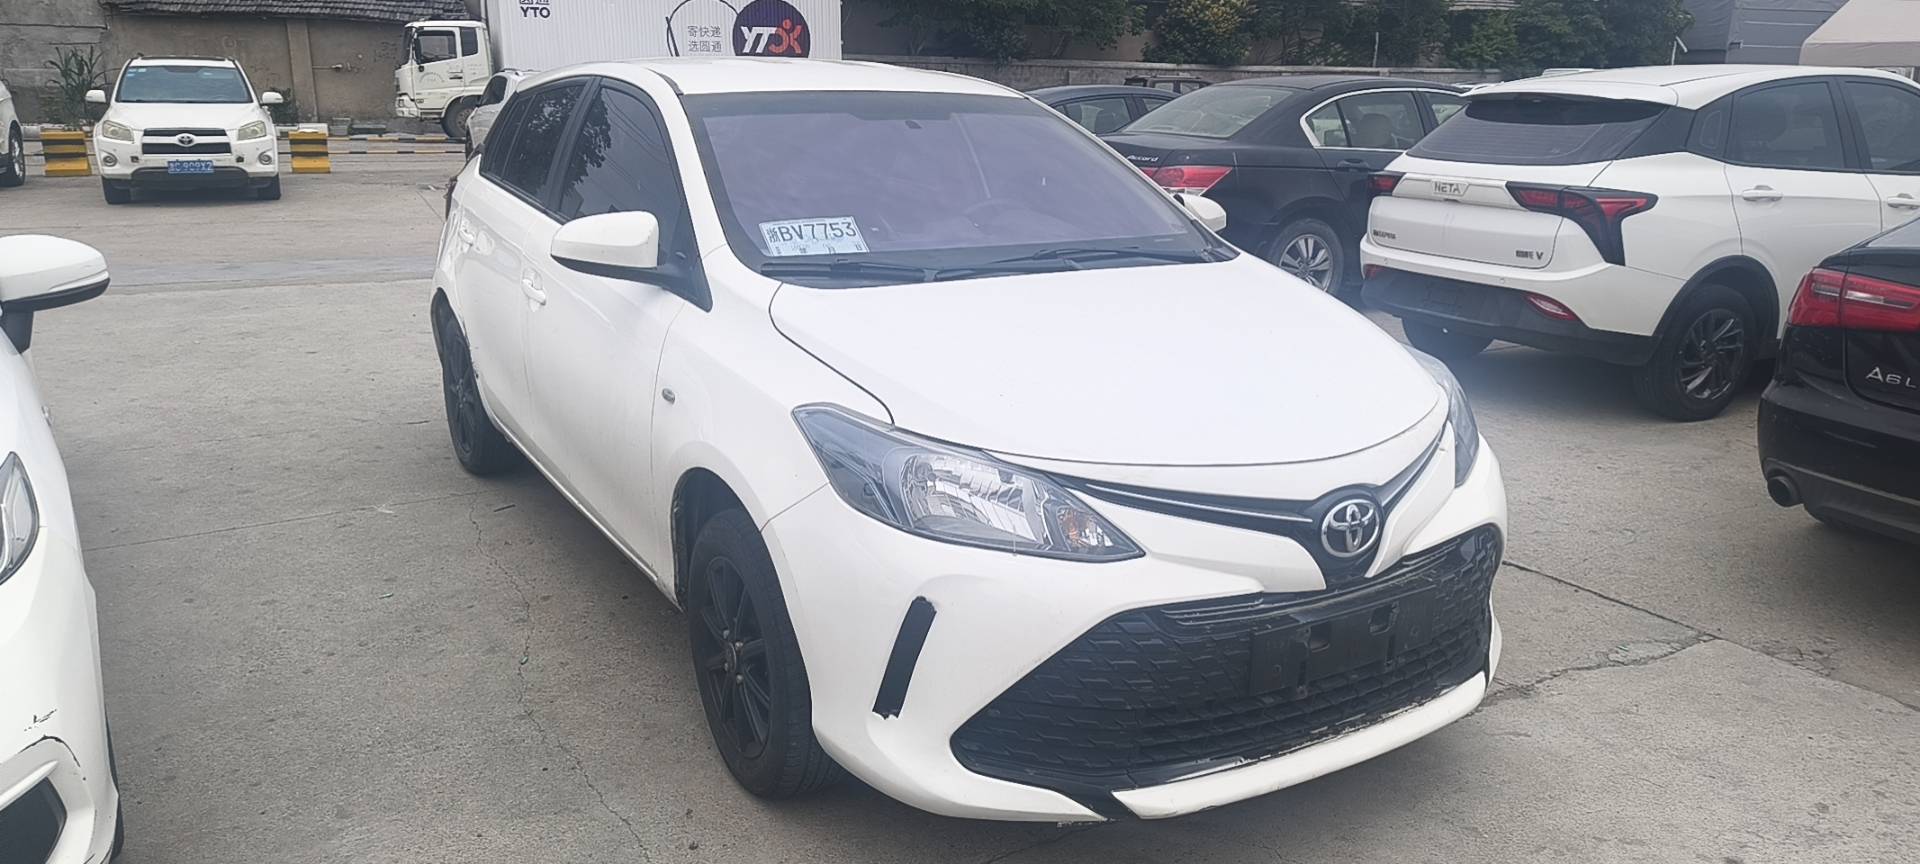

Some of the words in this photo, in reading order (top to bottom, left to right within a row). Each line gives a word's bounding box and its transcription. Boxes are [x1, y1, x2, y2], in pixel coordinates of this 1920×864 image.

[520, 6, 551, 18] YTO
[688, 25, 722, 38] 寄快递
[688, 40, 722, 53] 选圆通
[1127, 154, 1160, 162] Accord
[1434, 181, 1461, 194] NETA
[1865, 366, 1917, 388] A6L
